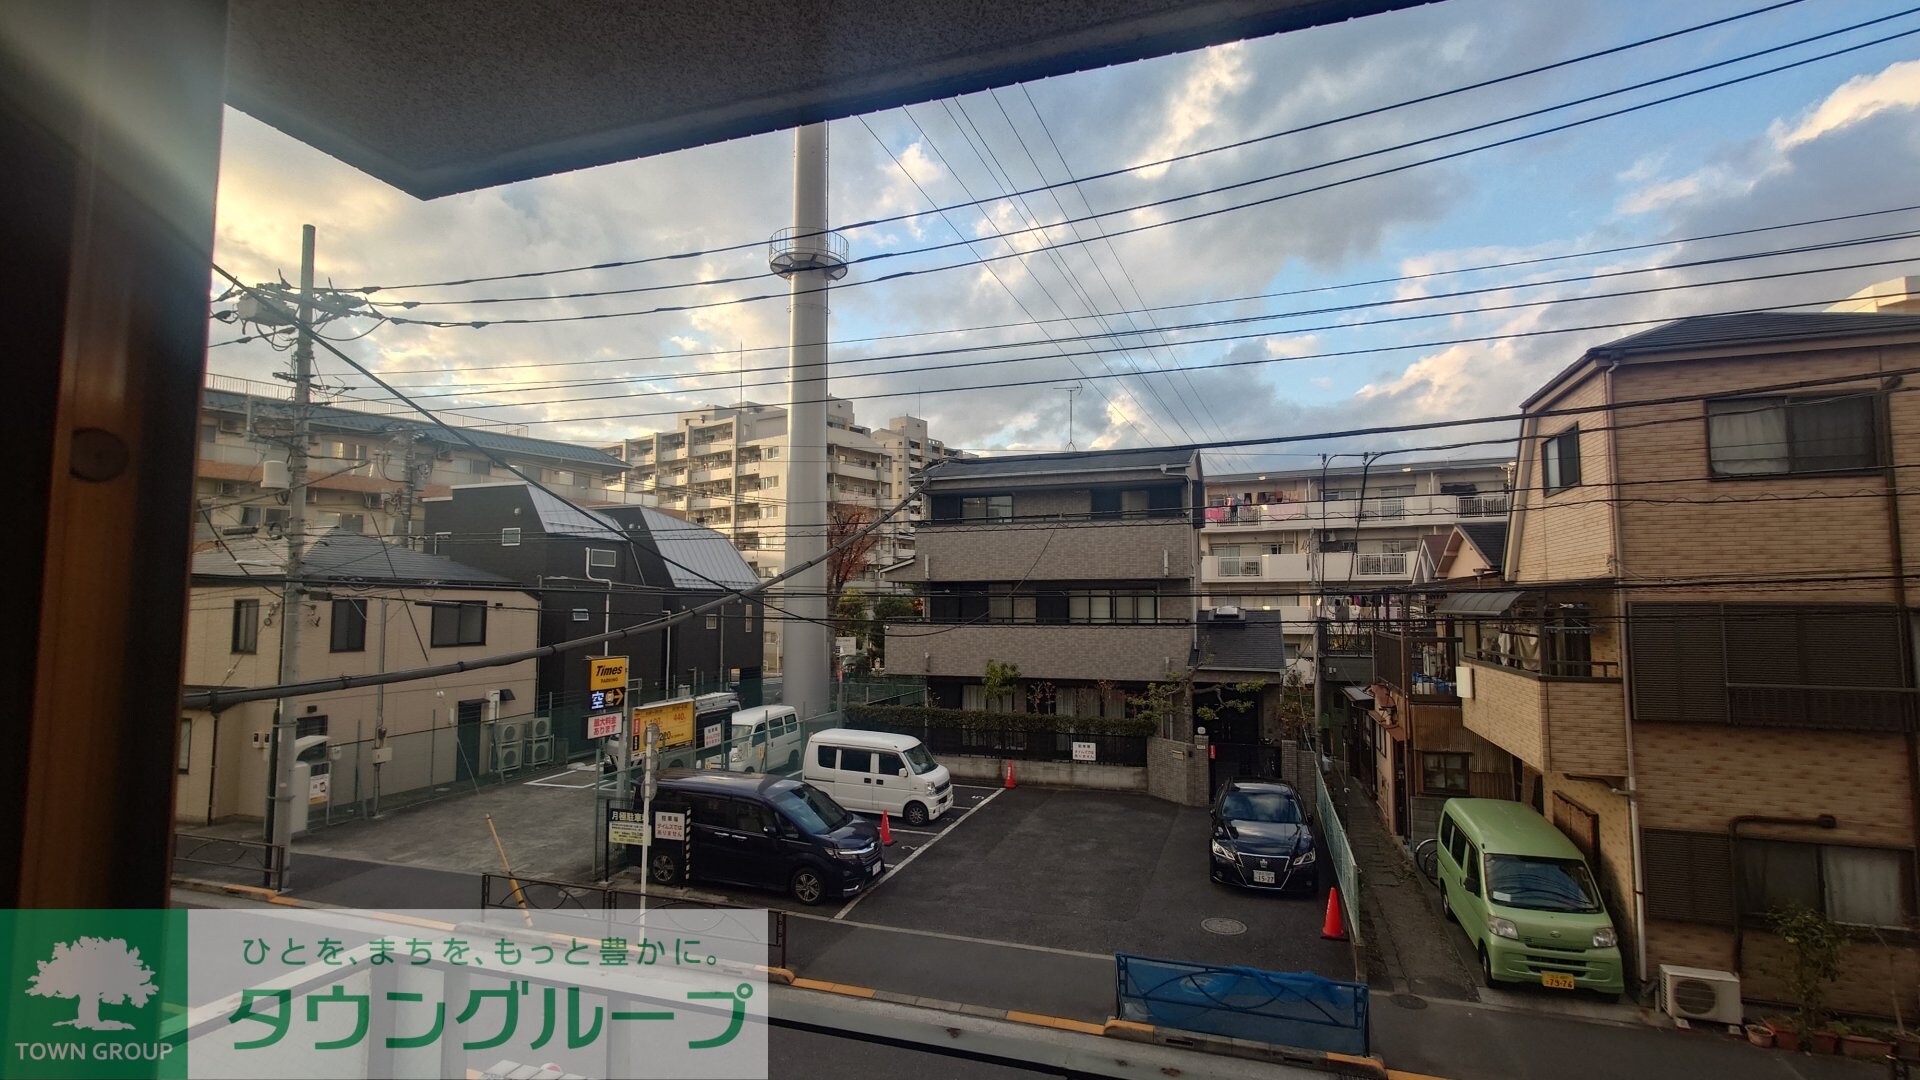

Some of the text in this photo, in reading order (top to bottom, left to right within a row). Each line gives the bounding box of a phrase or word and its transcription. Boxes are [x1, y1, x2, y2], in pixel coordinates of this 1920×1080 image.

[596, 665, 622, 676] Times
[591, 691, 604, 709] 空
[594, 716, 616, 727] 最大料金
[594, 725, 616, 735] あります
